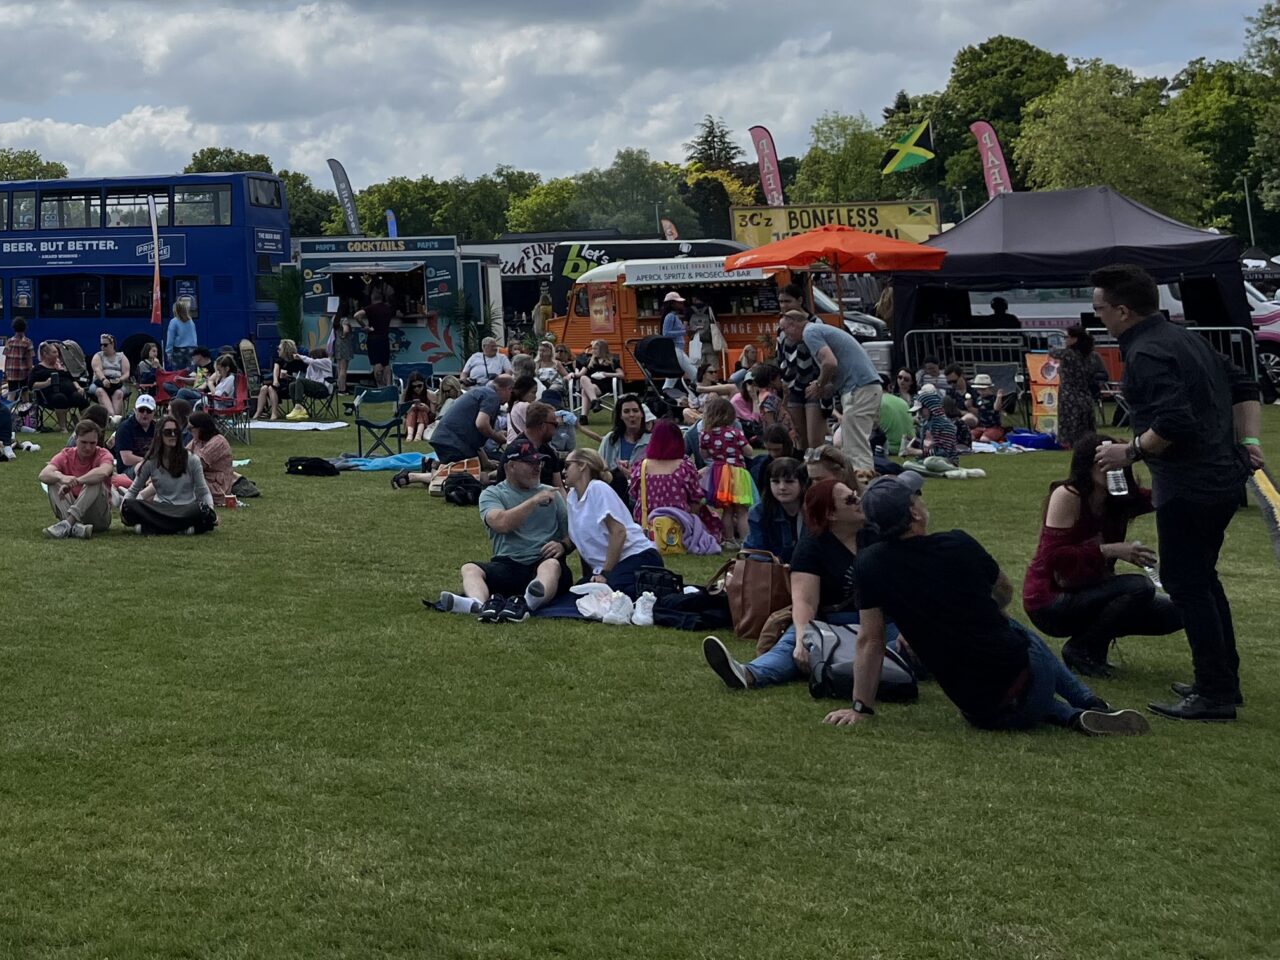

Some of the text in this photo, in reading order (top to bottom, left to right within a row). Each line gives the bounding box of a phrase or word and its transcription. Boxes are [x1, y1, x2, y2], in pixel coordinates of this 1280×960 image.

[787, 207, 879, 230] BONELESS
[3, 240, 118, 252] BEER. BUT BETTER.
[347, 241, 405, 252] COCKTAILS
[581, 244, 609, 264] let's
[635, 273, 663, 282] APEROL
[664, 272, 686, 281] SPRITZ
[695, 270, 735, 279] PROSECCO
[640, 325, 659, 335] THE
[723, 323, 752, 334] ANGE
